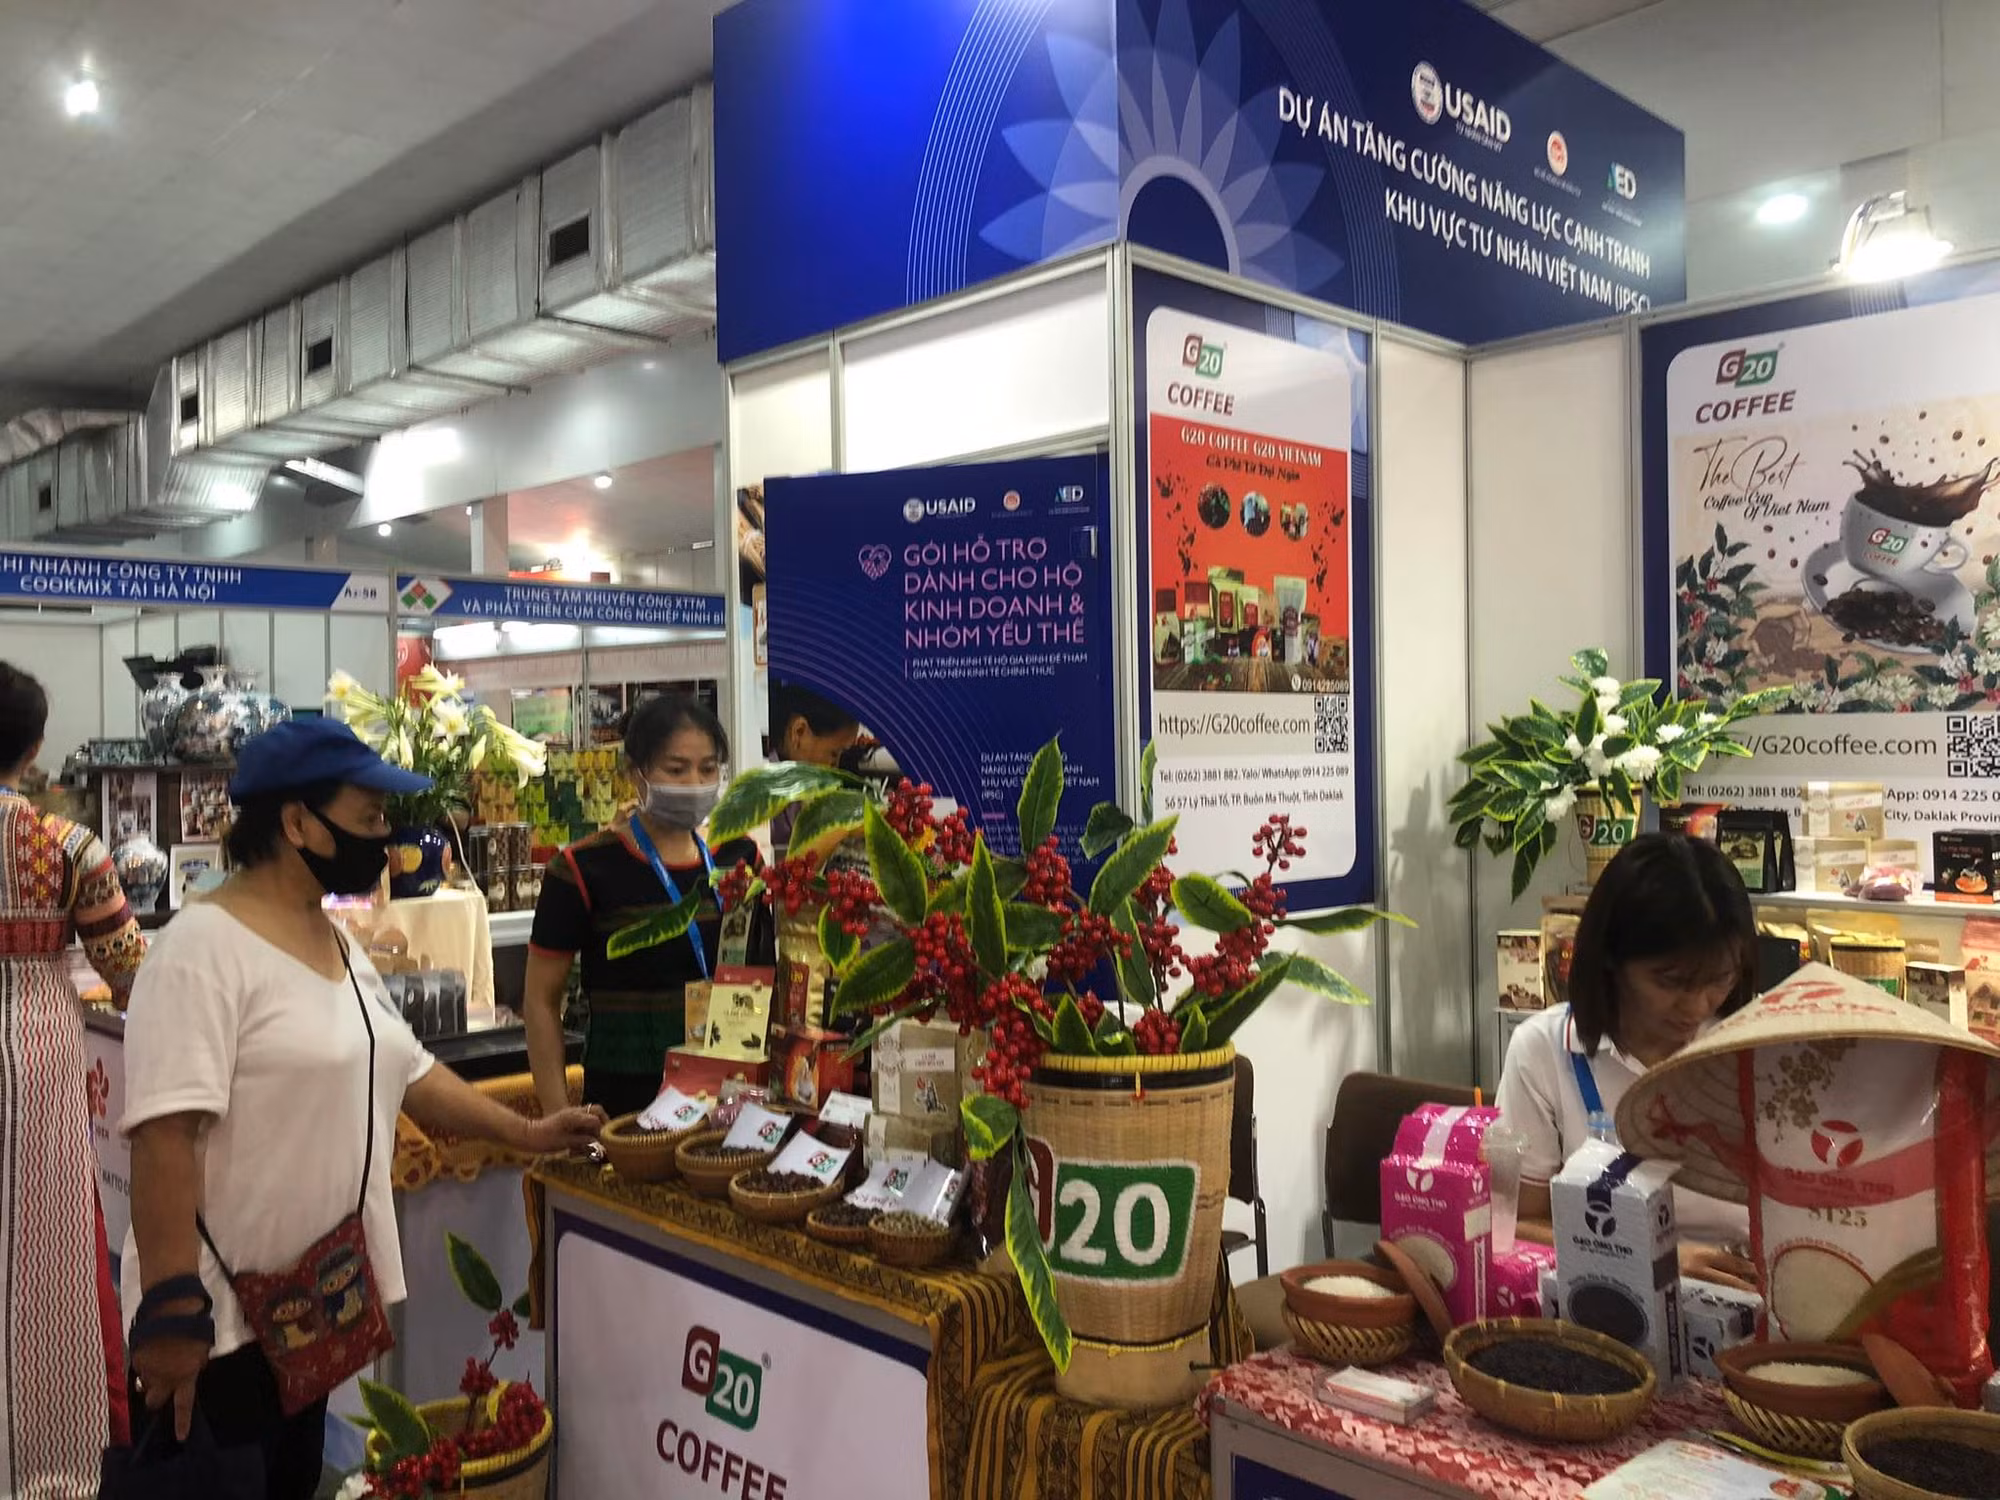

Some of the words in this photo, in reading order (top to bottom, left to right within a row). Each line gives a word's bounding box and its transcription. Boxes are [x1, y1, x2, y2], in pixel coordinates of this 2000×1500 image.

[1444, 83, 1511, 143] USAID
[1279, 85, 1313, 136] DỰ
[1318, 101, 1348, 147] ÁN
[1352, 119, 1406, 173] TĂNG
[1410, 148, 1477, 199] CƯỜNG
[1482, 178, 1529, 226] NĂNG
[1532, 206, 1561, 242] LỰC
[1564, 221, 1604, 260] CẠNH
[1604, 237, 1651, 279] TRANH
[1386, 187, 1425, 232] KHU
[1429, 207, 1467, 249] VỰC
[1469, 225, 1494, 257] TƯ
[1497, 235, 1543, 278] NHÂN
[1545, 256, 1577, 295] VIỆT
[1580, 272, 1612, 305] NAM
[1184, 336, 1222, 375] G20
[1718, 351, 1774, 384] G20
[1168, 382, 1235, 416] COFFEE
[1695, 390, 1797, 424] COFFEE
[1181, 425, 1205, 446] G20
[1209, 431, 1250, 455] COFFEE
[1253, 441, 1276, 459] G20
[1278, 444, 1322, 468] VIETNAM
[1694, 437, 1747, 492] The
[1731, 436, 1806, 497] Best
[926, 497, 976, 516] USAID
[1704, 490, 1746, 511] Coffee
[1747, 490, 1774, 507] Cup
[1743, 503, 1762, 521] Of
[1796, 498, 1830, 514] Nam
[904, 540, 946, 567] GÓI
[996, 537, 1047, 563] TRỢ
[1870, 528, 1906, 552] G20
[0, 556, 23, 573] HI
[168, 565, 191, 582] TY
[193, 567, 241, 584] TNHH
[1862, 550, 1900, 566] COFFEE
[20, 575, 112, 596] COOKMIX
[981, 567, 1037, 590] CHO
[504, 587, 550, 602] TRUNG
[682, 611, 711, 625] NINH
[904, 599, 962, 622] KINH
[969, 595, 1062, 619] DOANH
[1069, 594, 1085, 615] &
[904, 625, 980, 649] NHÓM
[961, 655, 982, 667] KINH
[967, 666, 989, 678] KINH
[1159, 712, 1310, 740] https://G20coffee.com
[1160, 769, 1173, 783] Tel:
[1175, 769, 1201, 784] (0262)
[1202, 768, 1222, 781] 3881
[1302, 766, 1320, 778] 0914
[1321, 766, 1335, 777] 225
[1336, 766, 1349, 777] 089
[1265, 792, 1277, 804] Ma
[1320, 789, 1344, 801] Daklak
[1686, 785, 1704, 797] Tel:
[1707, 785, 1744, 798] (0262)
[1748, 786, 1776, 797] 3881
[1922, 789, 1957, 801] 0914
[1962, 790, 1988, 802] 225
[1884, 810, 1911, 822] City,
[1914, 810, 1957, 822] Daklak
[1961, 811, 2000, 823] Provin
[1580, 816, 1625, 844] G20
[687, 1337, 756, 1419] G20
[656, 1418, 788, 1500] COFFEE
